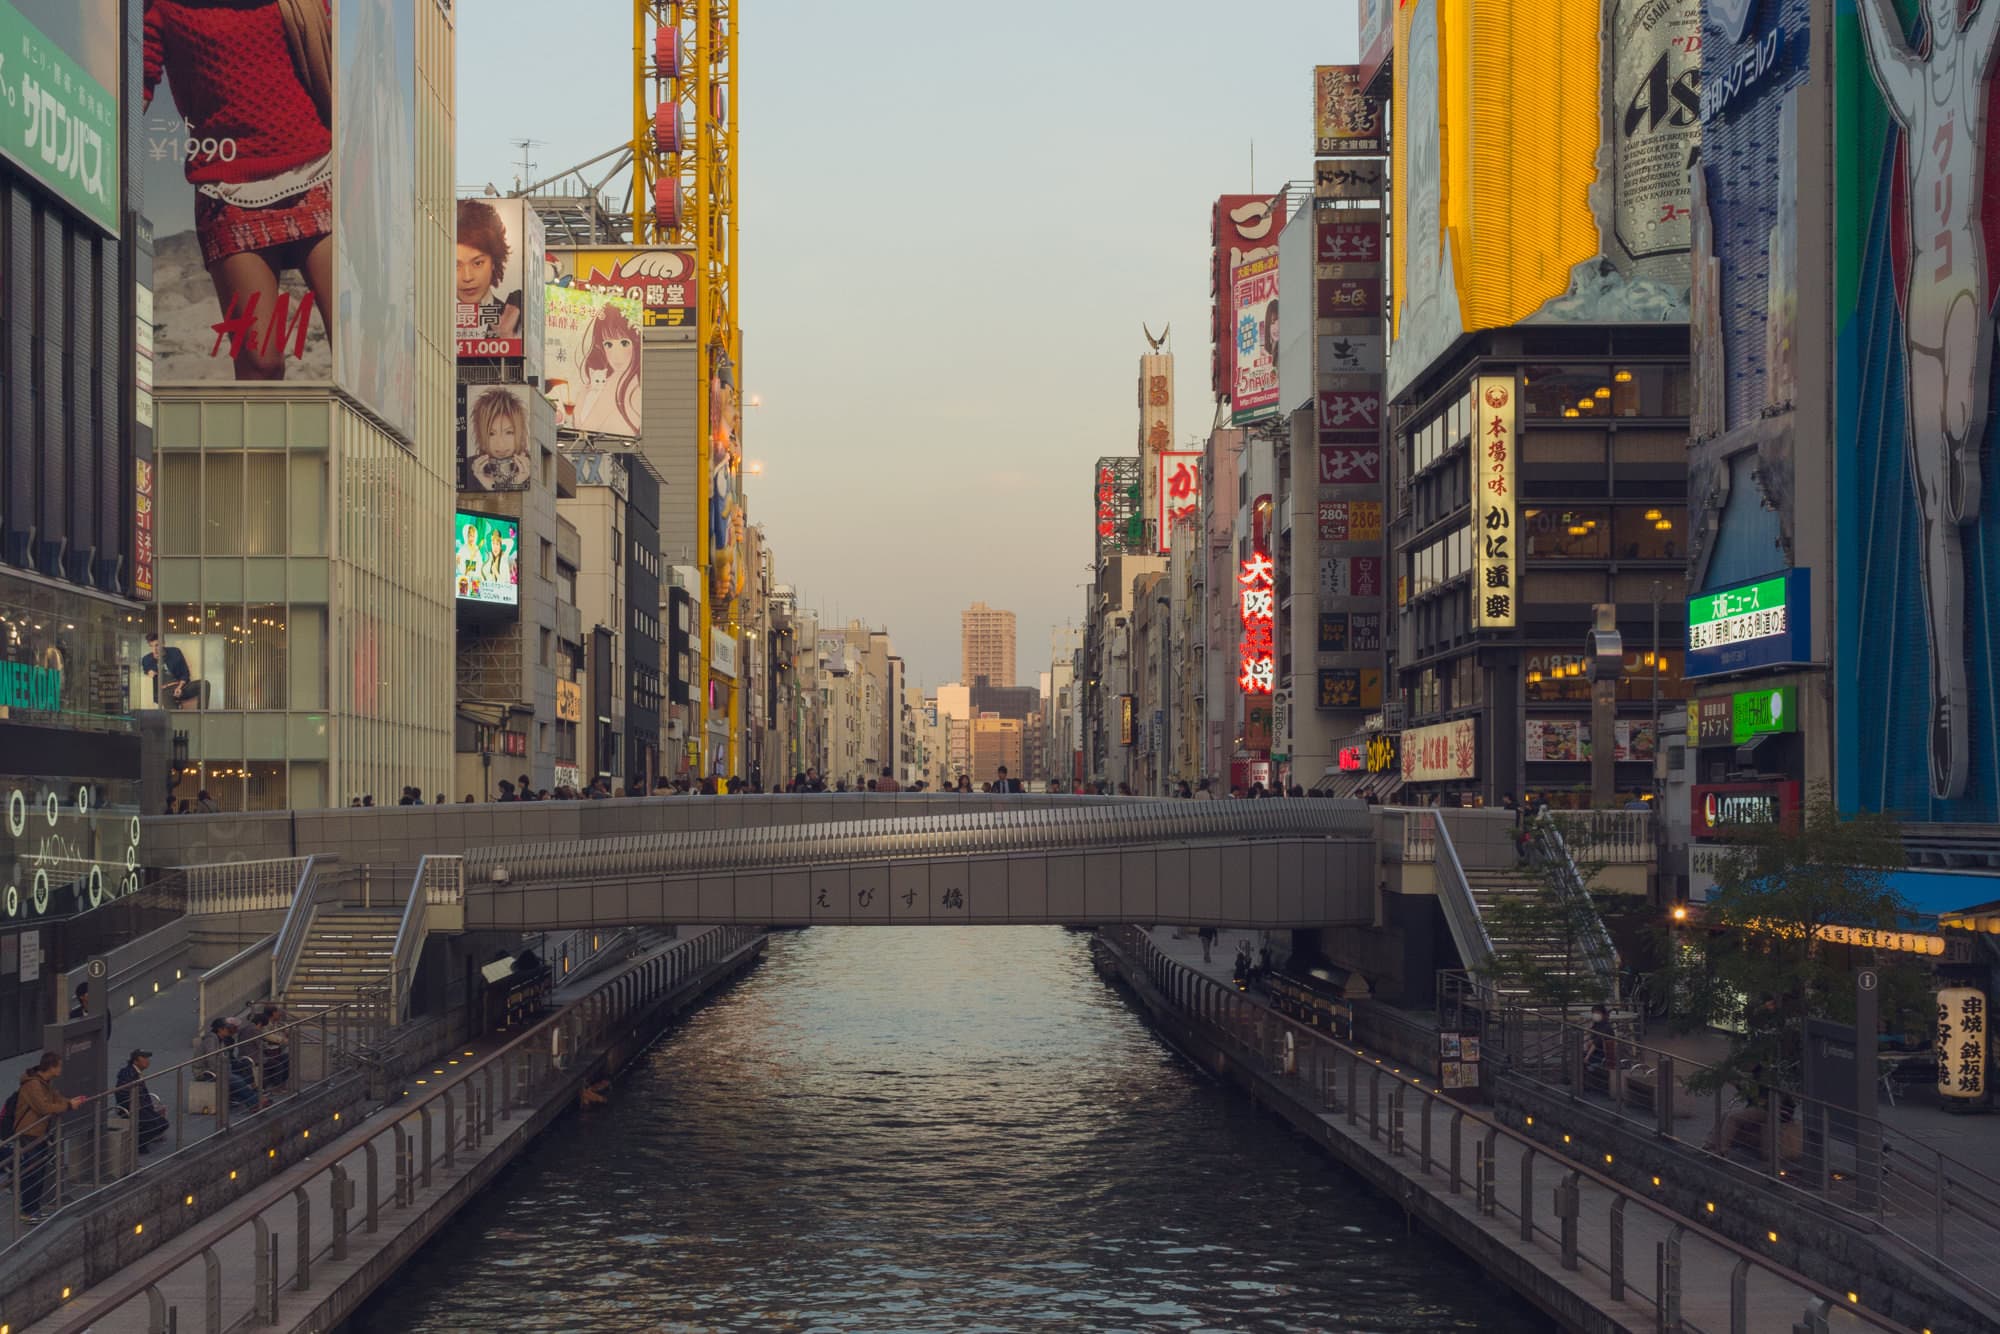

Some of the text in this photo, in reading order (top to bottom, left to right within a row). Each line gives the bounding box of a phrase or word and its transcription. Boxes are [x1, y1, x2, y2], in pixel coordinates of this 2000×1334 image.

[22, 71, 105, 203] サロンパス
[149, 116, 195, 133] ニット
[1322, 138, 1337, 150] 9F
[1932, 107, 1954, 284] グリコ
[211, 291, 314, 360] H&M
[1486, 416, 1508, 497] 本場の味
[1320, 509, 1348, 521] 280円
[1485, 505, 1510, 619] かに道楽
[1711, 586, 1761, 620] 大阪ニュース
[0, 660, 61, 711] WEEKDAY
[1717, 796, 1774, 824] LOTTERIA
[816, 887, 964, 910] えびす橋
[1958, 996, 1983, 1092] 串焼・鉄板焼
